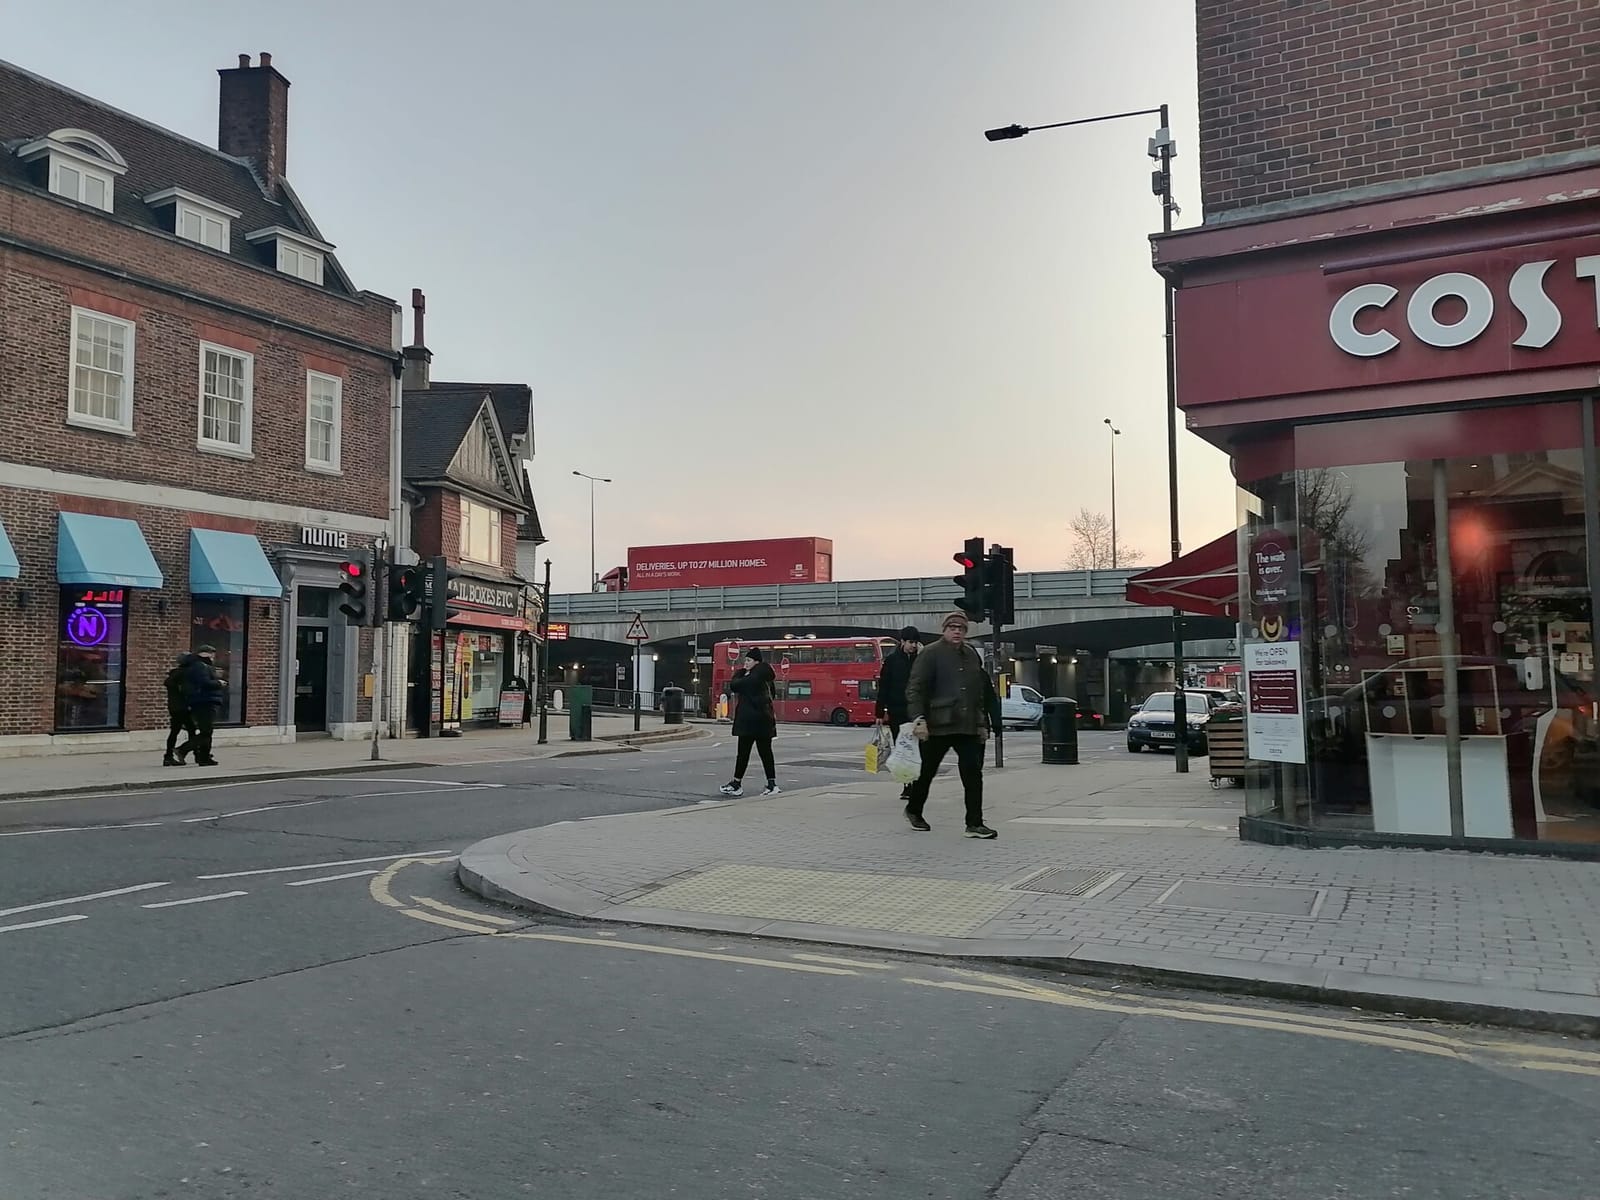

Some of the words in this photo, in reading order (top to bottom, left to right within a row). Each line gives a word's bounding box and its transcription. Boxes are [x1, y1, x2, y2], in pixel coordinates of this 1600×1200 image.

[302, 526, 348, 549] numa
[636, 562, 676, 571] DELIVERIES.
[677, 562, 688, 570] UP
[689, 561, 699, 569] TO
[698, 560, 708, 569] 27
[708, 559, 738, 568] MILLION
[739, 558, 768, 567] HOMES.
[1255, 552, 1269, 564] The
[1258, 564, 1265, 575] is
[1265, 566, 1283, 574] over.
[447, 580, 468, 602] AIL
[469, 584, 496, 605] BOXES
[496, 590, 514, 609] ETC.
[78, 615, 97, 638] N
[1269, 647, 1288, 656] OPEN
